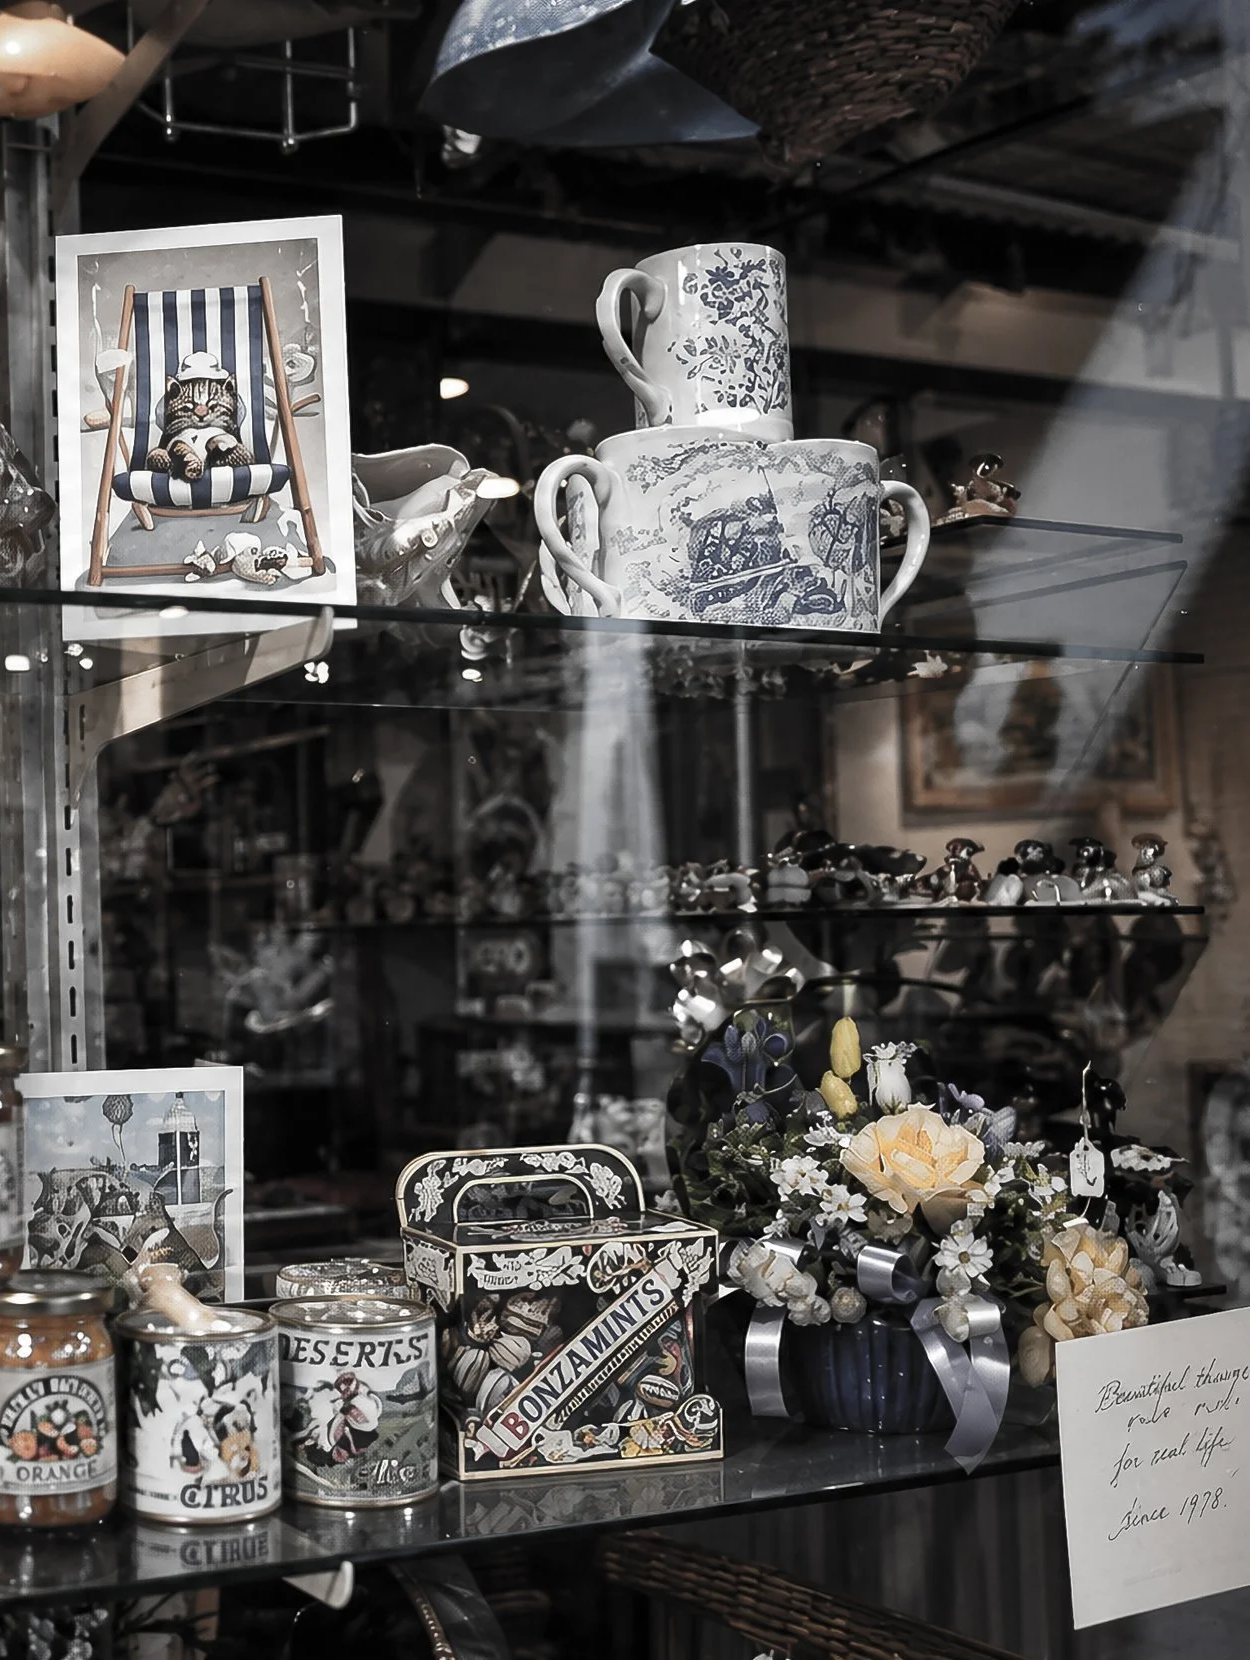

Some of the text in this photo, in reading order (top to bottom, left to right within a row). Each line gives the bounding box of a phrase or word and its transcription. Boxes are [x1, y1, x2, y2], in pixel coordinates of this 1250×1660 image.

[501, 1278, 666, 1442] BONZAMINTS
[16, 1459, 97, 1482] ORANGE
[1110, 1443, 1142, 1488] for
[180, 1475, 268, 1509] CITRUS
